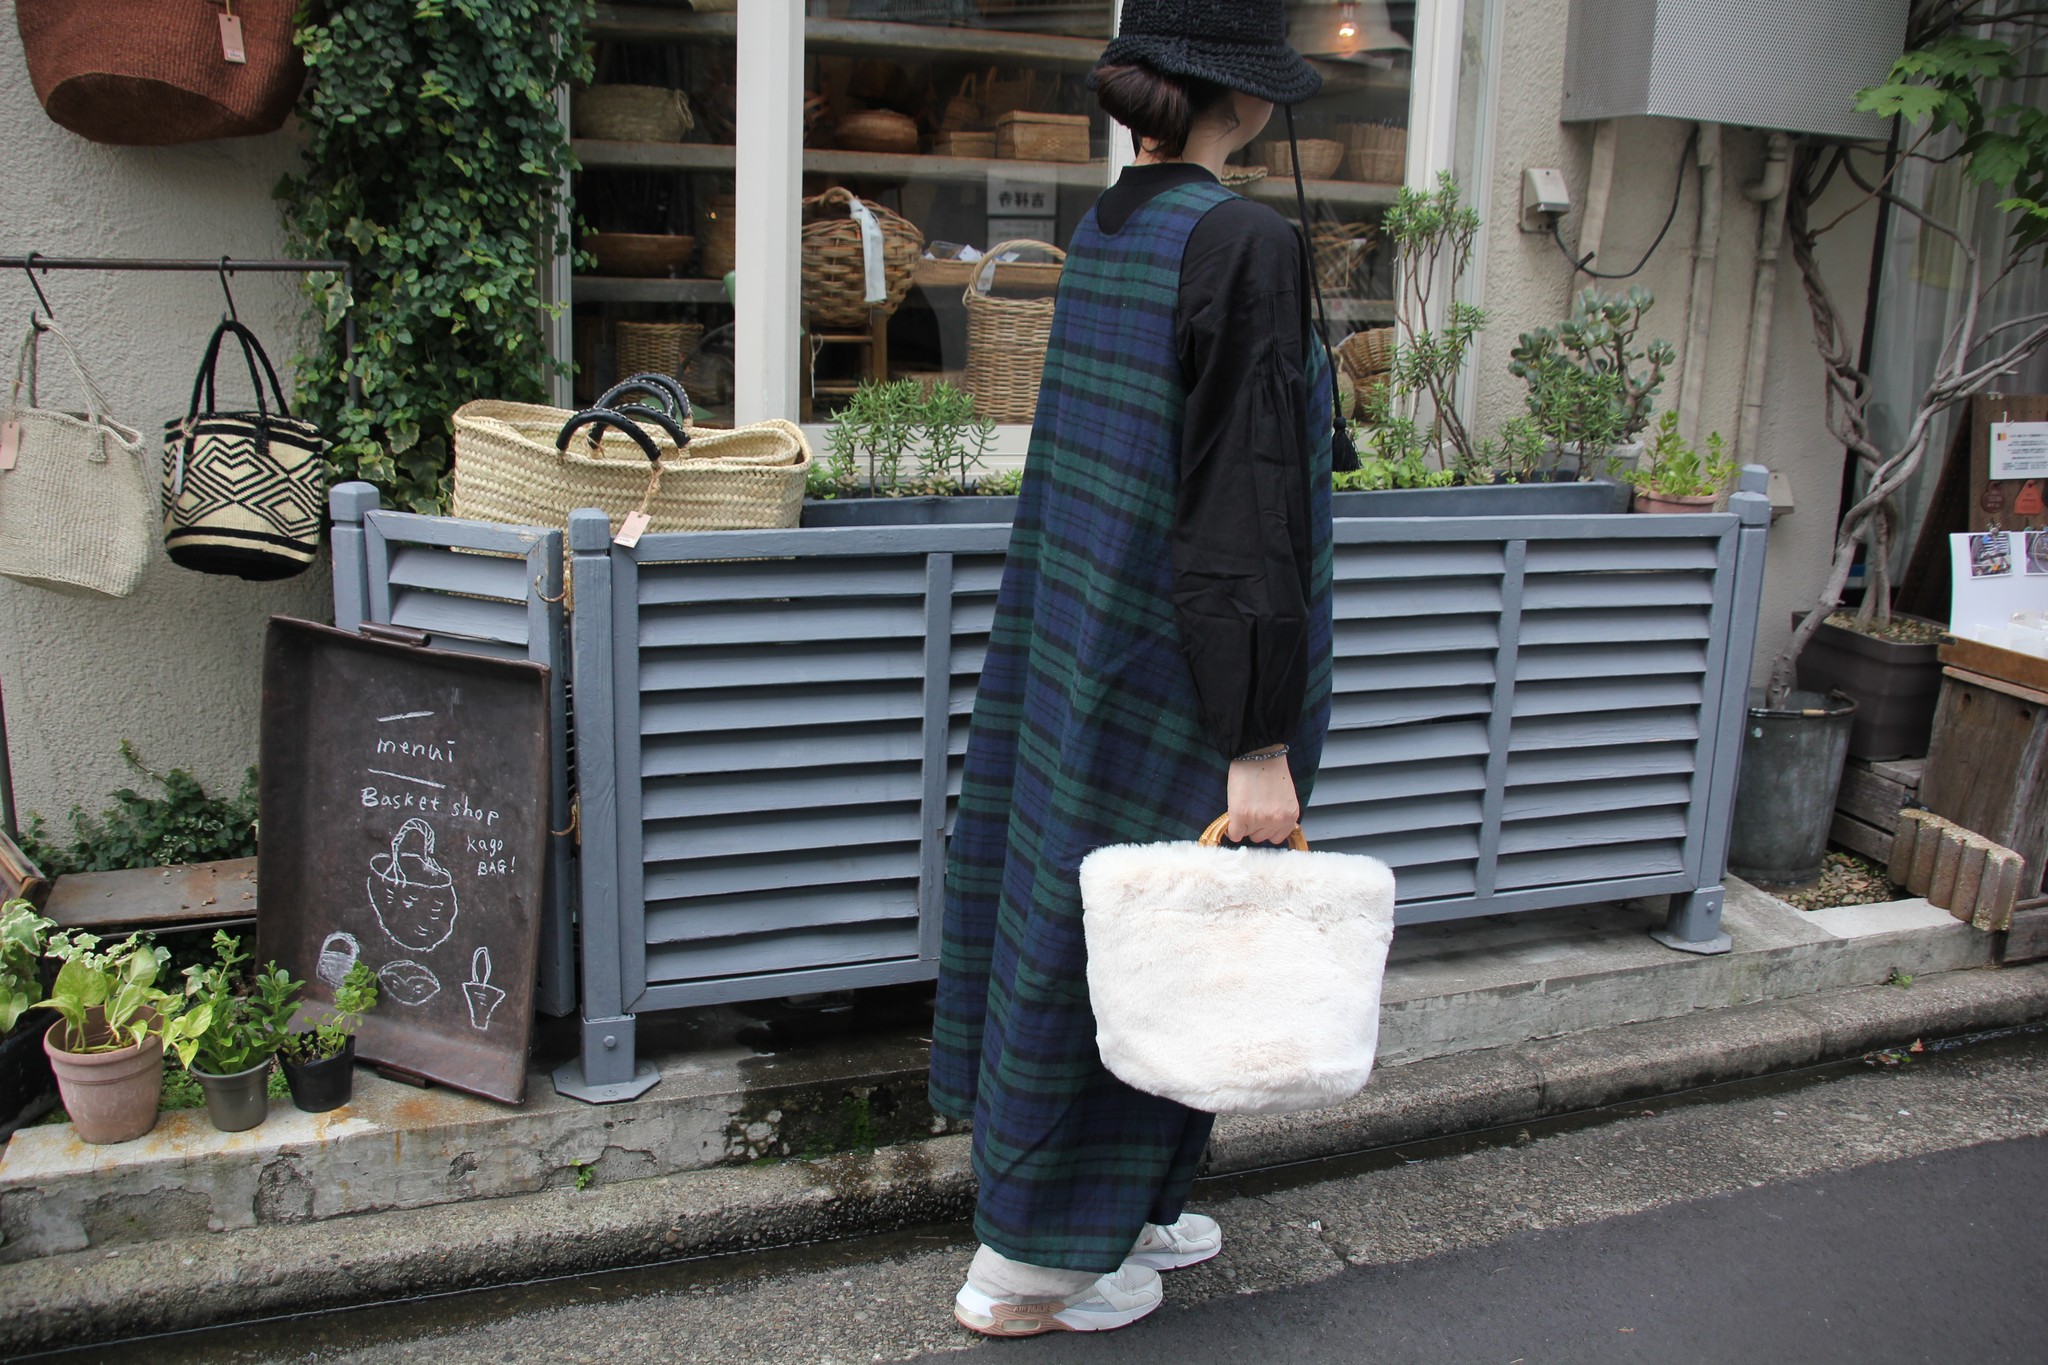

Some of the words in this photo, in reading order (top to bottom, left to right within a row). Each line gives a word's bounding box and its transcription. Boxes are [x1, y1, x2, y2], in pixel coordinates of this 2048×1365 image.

[376, 738, 456, 763] menui
[360, 786, 440, 811] Basket
[451, 795, 500, 826] shop
[477, 856, 516, 877] BAG!
